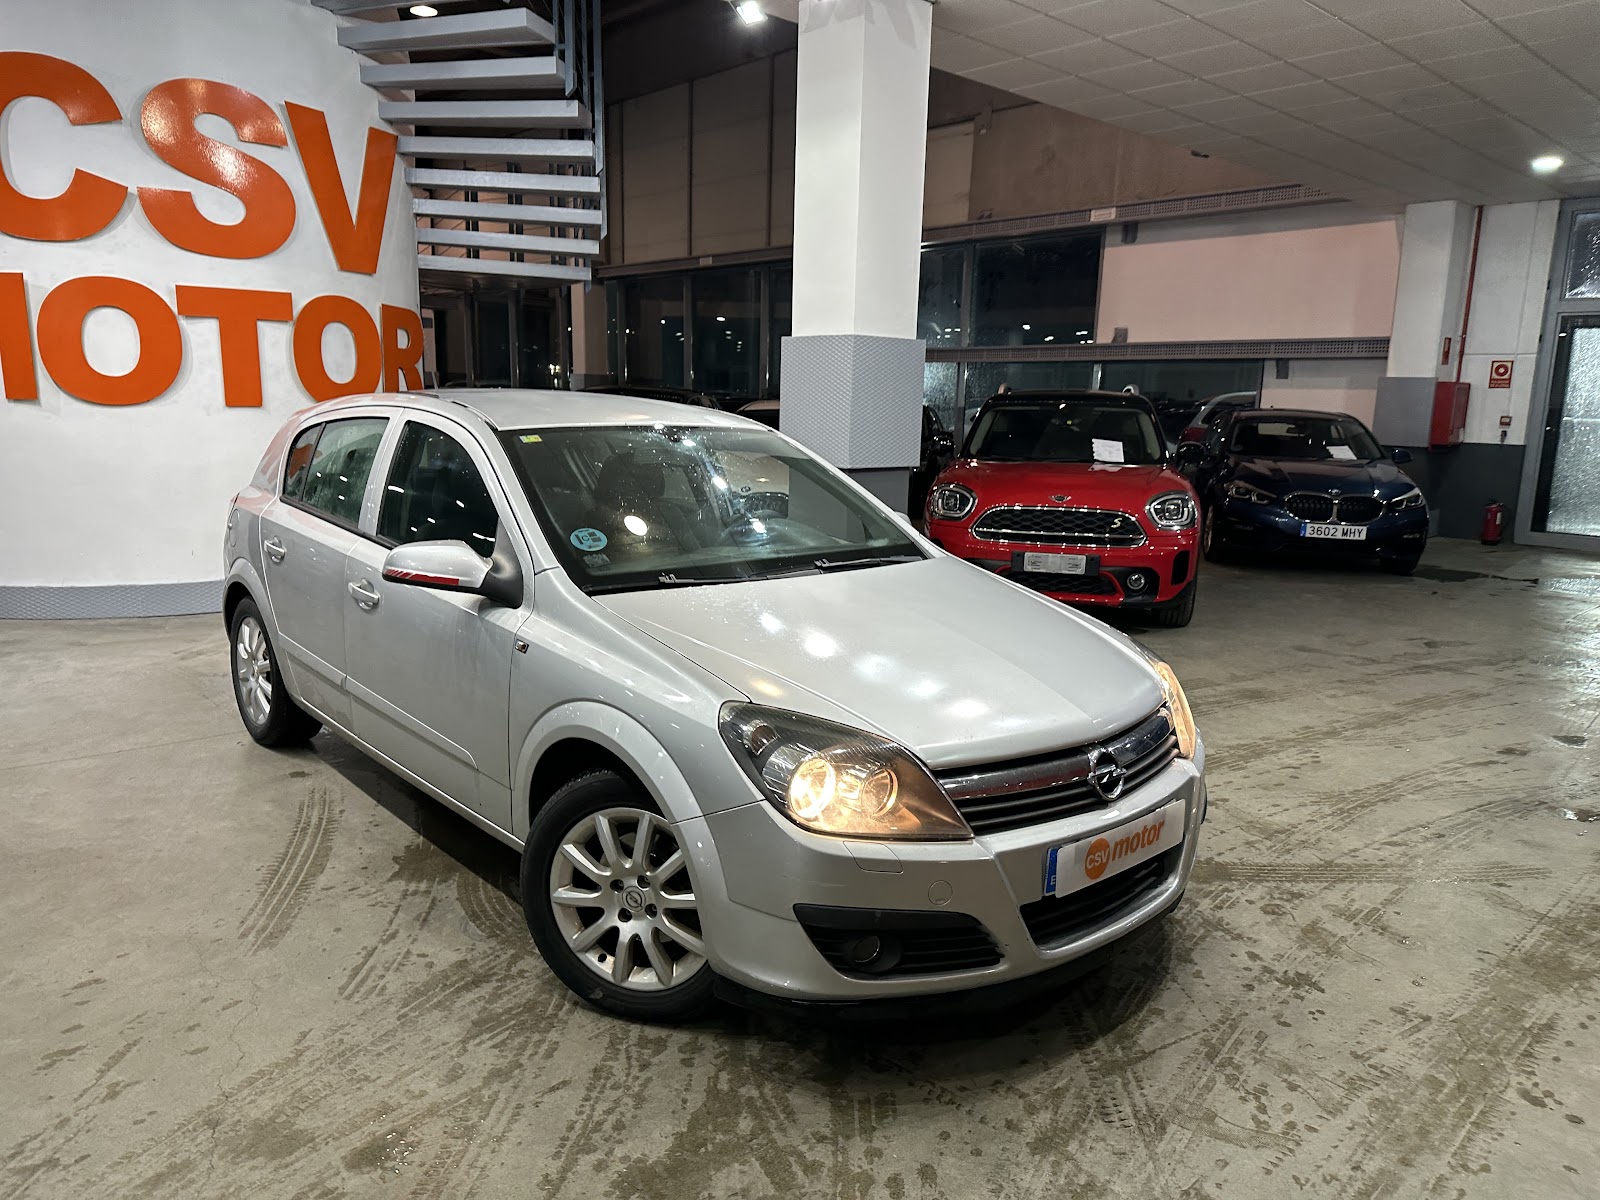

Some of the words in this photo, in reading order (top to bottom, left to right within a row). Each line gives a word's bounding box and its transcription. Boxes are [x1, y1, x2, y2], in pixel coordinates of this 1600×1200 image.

[0, 51, 399, 275] CSV
[1308, 525, 1338, 537] 3602
[1341, 527, 1363, 538] MHY
[1112, 820, 1165, 861] motor
